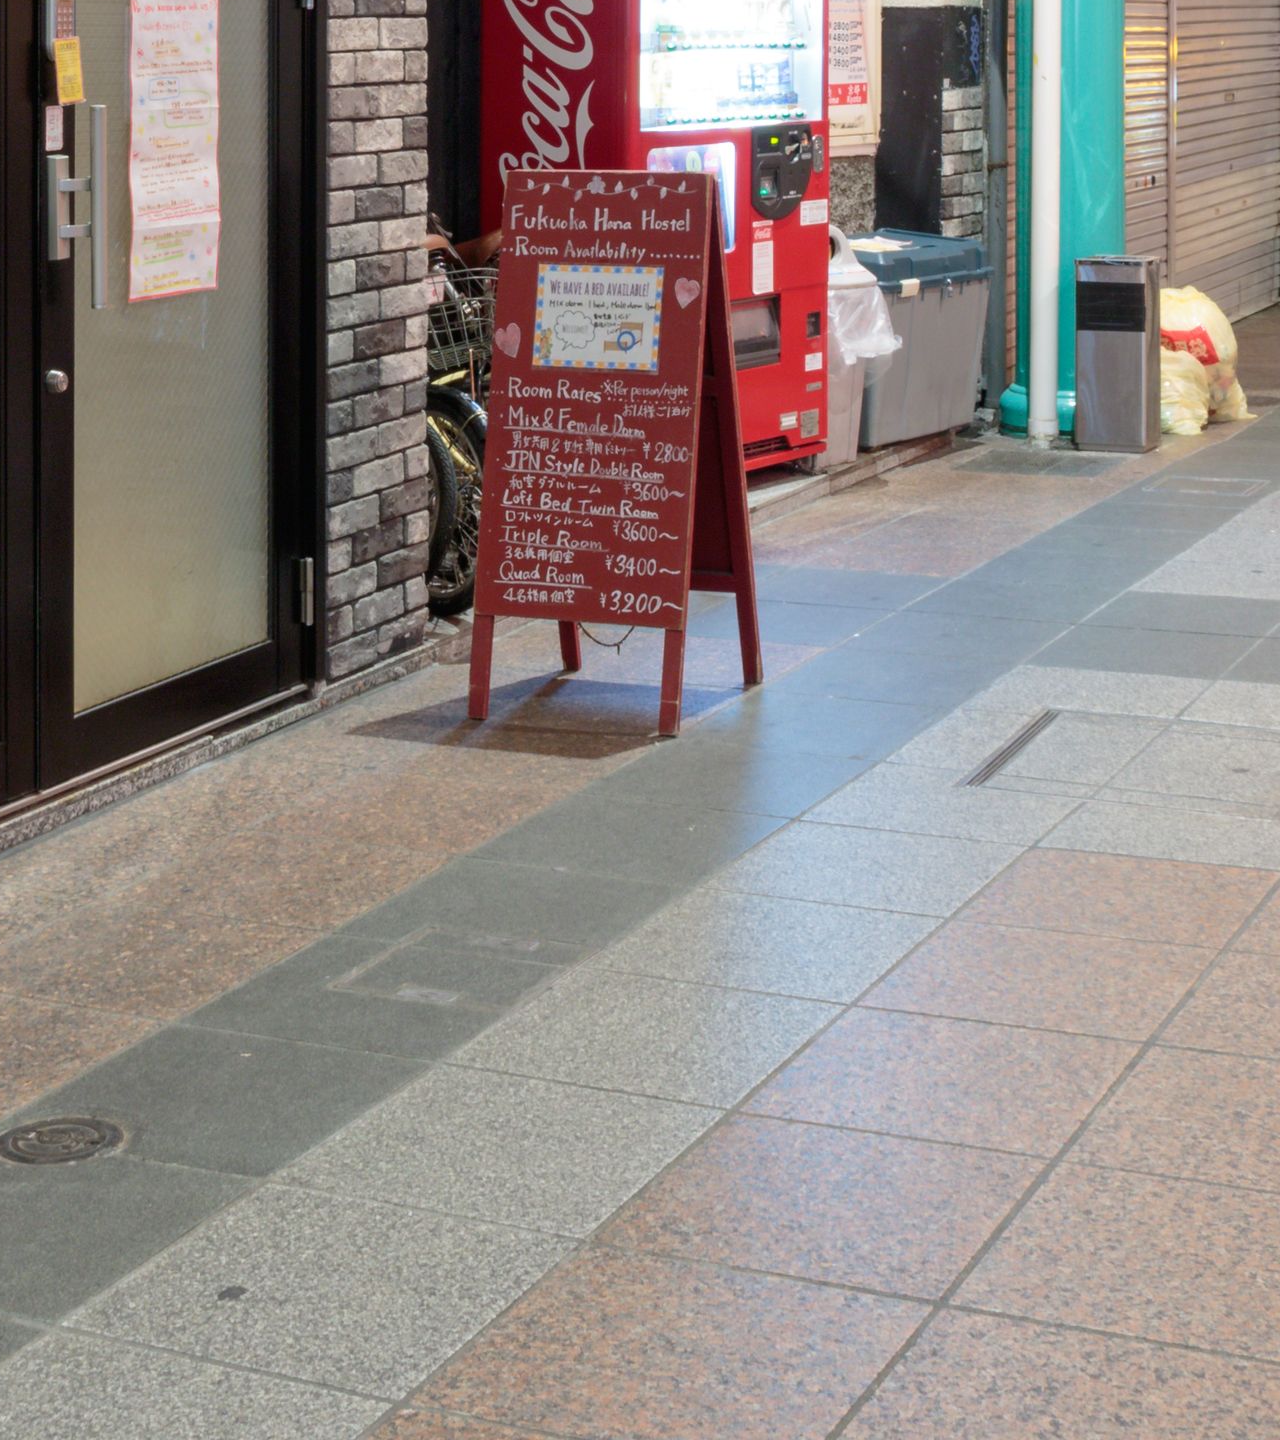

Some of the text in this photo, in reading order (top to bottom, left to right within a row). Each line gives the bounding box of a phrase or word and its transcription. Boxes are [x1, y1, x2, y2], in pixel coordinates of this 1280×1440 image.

[510, 204, 690, 232] Fukuoka Hana Hostel
[515, 235, 646, 263] Room Availability
[550, 279, 650, 297] WE HAVE A BED AVAILABLE!
[508, 376, 552, 399] Room
[557, 378, 602, 404] Rates
[612, 414, 646, 439] Dorm
[504, 449, 664, 481] JPN Style Double Room
[502, 489, 659, 519] Loft Bed Twin Room
[501, 525, 603, 550] Triple Room
[499, 560, 585, 585] Quad Room
